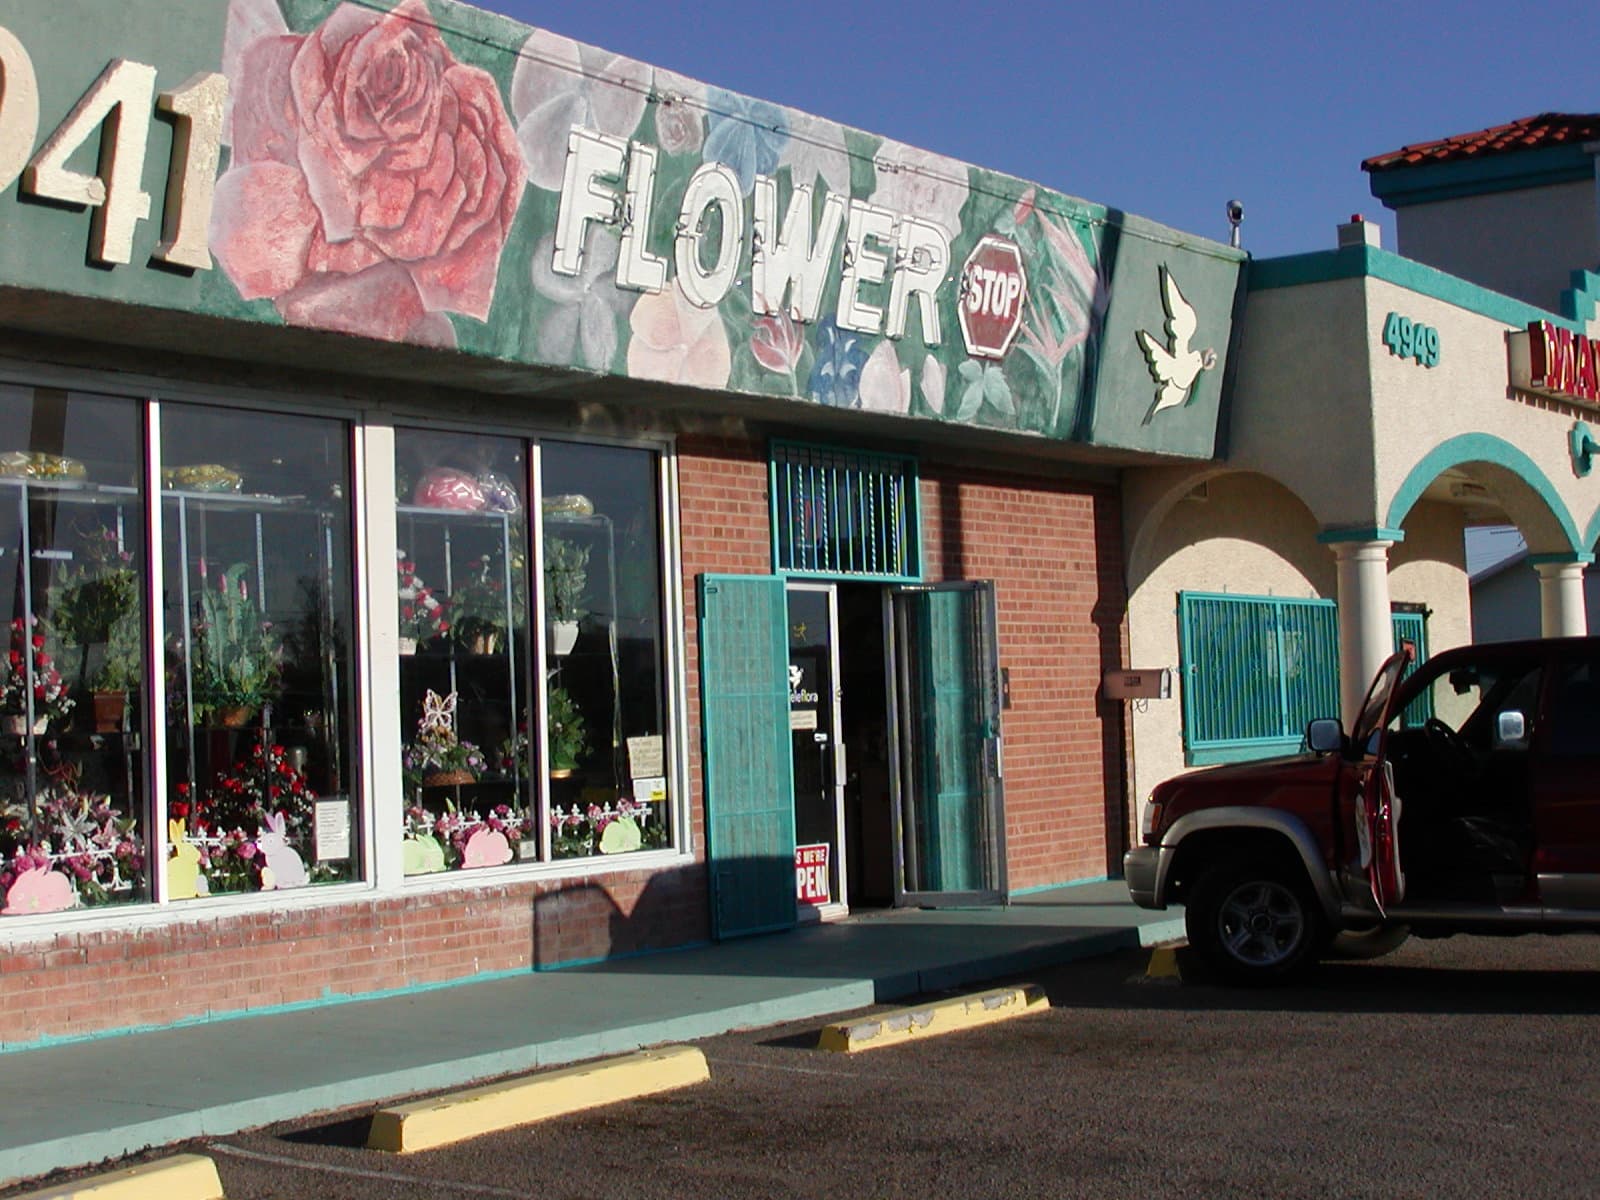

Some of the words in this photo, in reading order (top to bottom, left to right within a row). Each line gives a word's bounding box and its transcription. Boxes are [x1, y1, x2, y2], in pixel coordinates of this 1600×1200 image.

[552, 123, 954, 347] FLOWER
[966, 264, 1021, 319] STOP
[1383, 311, 1440, 368] 4949
[1529, 319, 1600, 402] MA
[790, 688, 819, 703] eleflora
[796, 865, 828, 899] PEN
